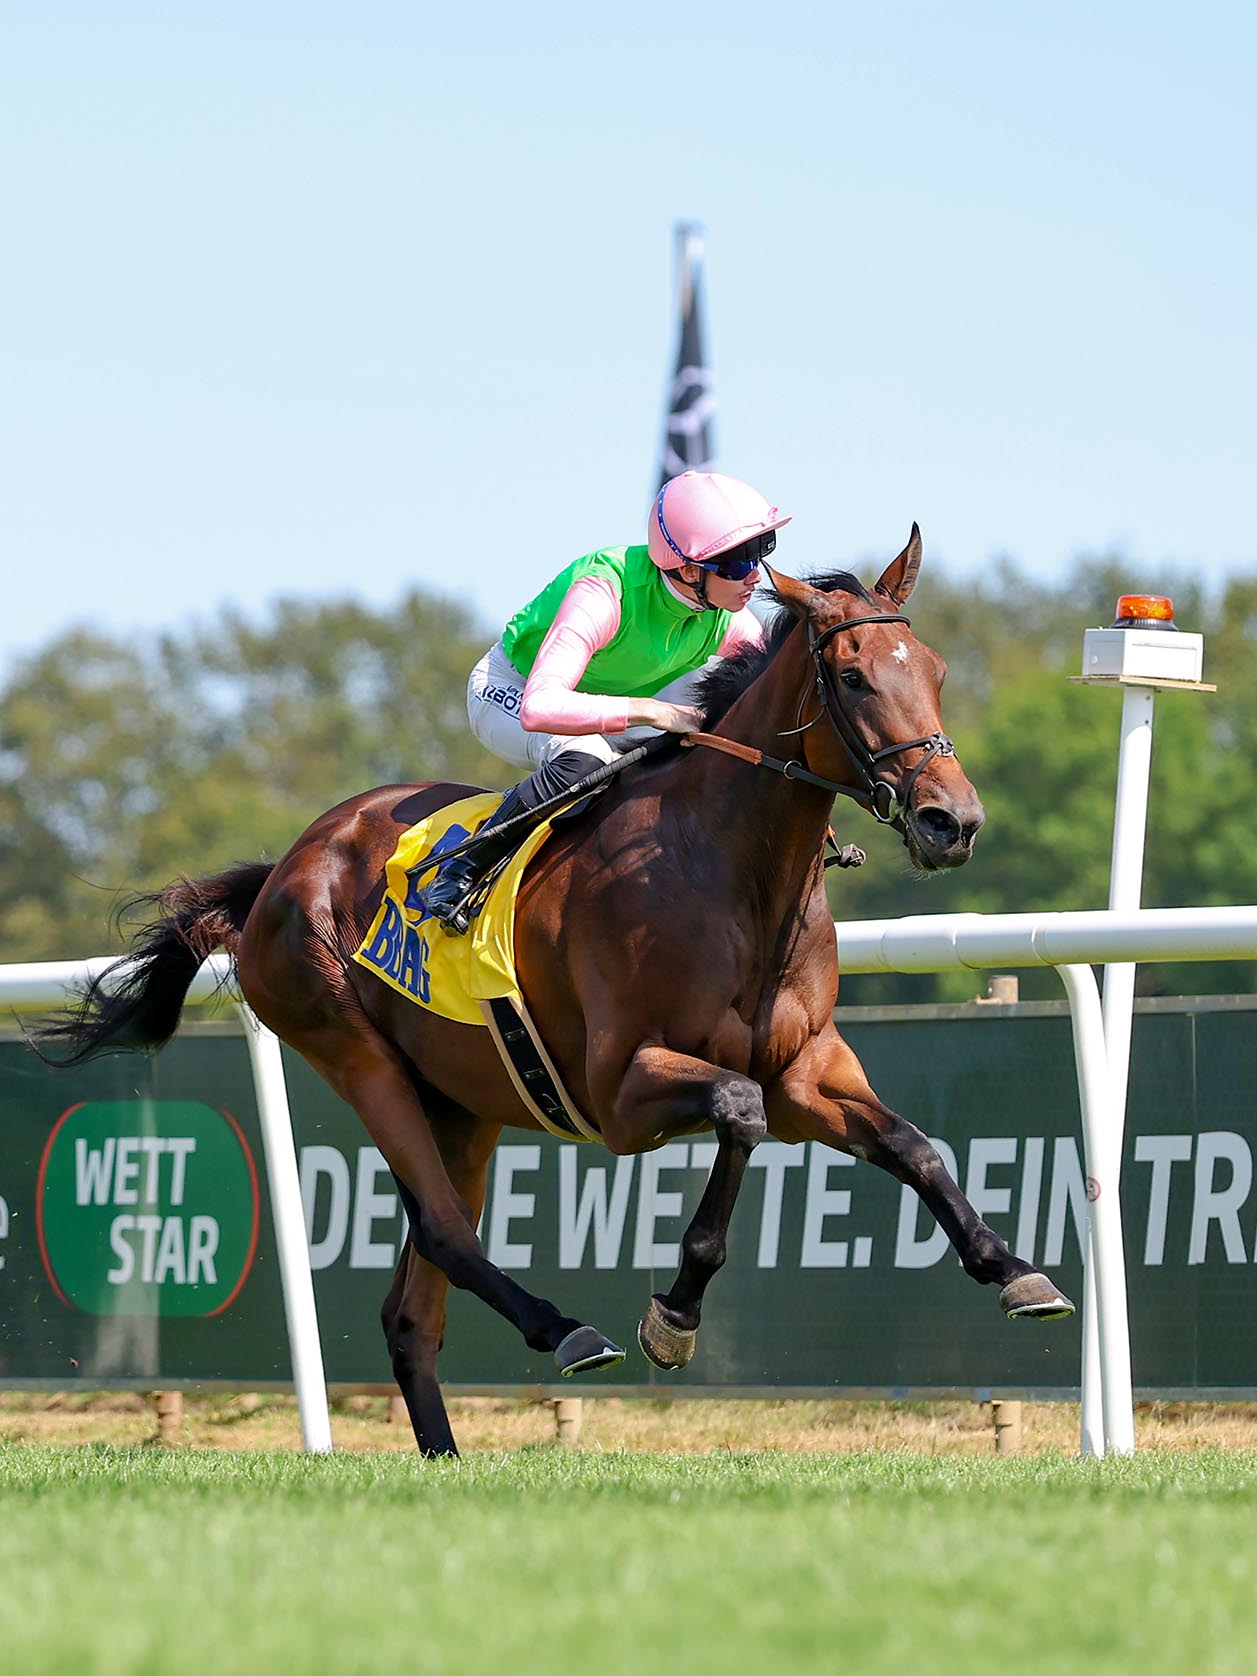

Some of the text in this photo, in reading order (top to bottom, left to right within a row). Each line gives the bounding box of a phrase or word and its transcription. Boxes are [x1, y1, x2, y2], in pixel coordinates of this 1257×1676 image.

[75, 1136, 197, 1206] WETT
[300, 1145, 542, 1270] DEE
[559, 1140, 872, 1269] WETE.
[1134, 1131, 1257, 1265] TR
[107, 1214, 220, 1285] STAR
